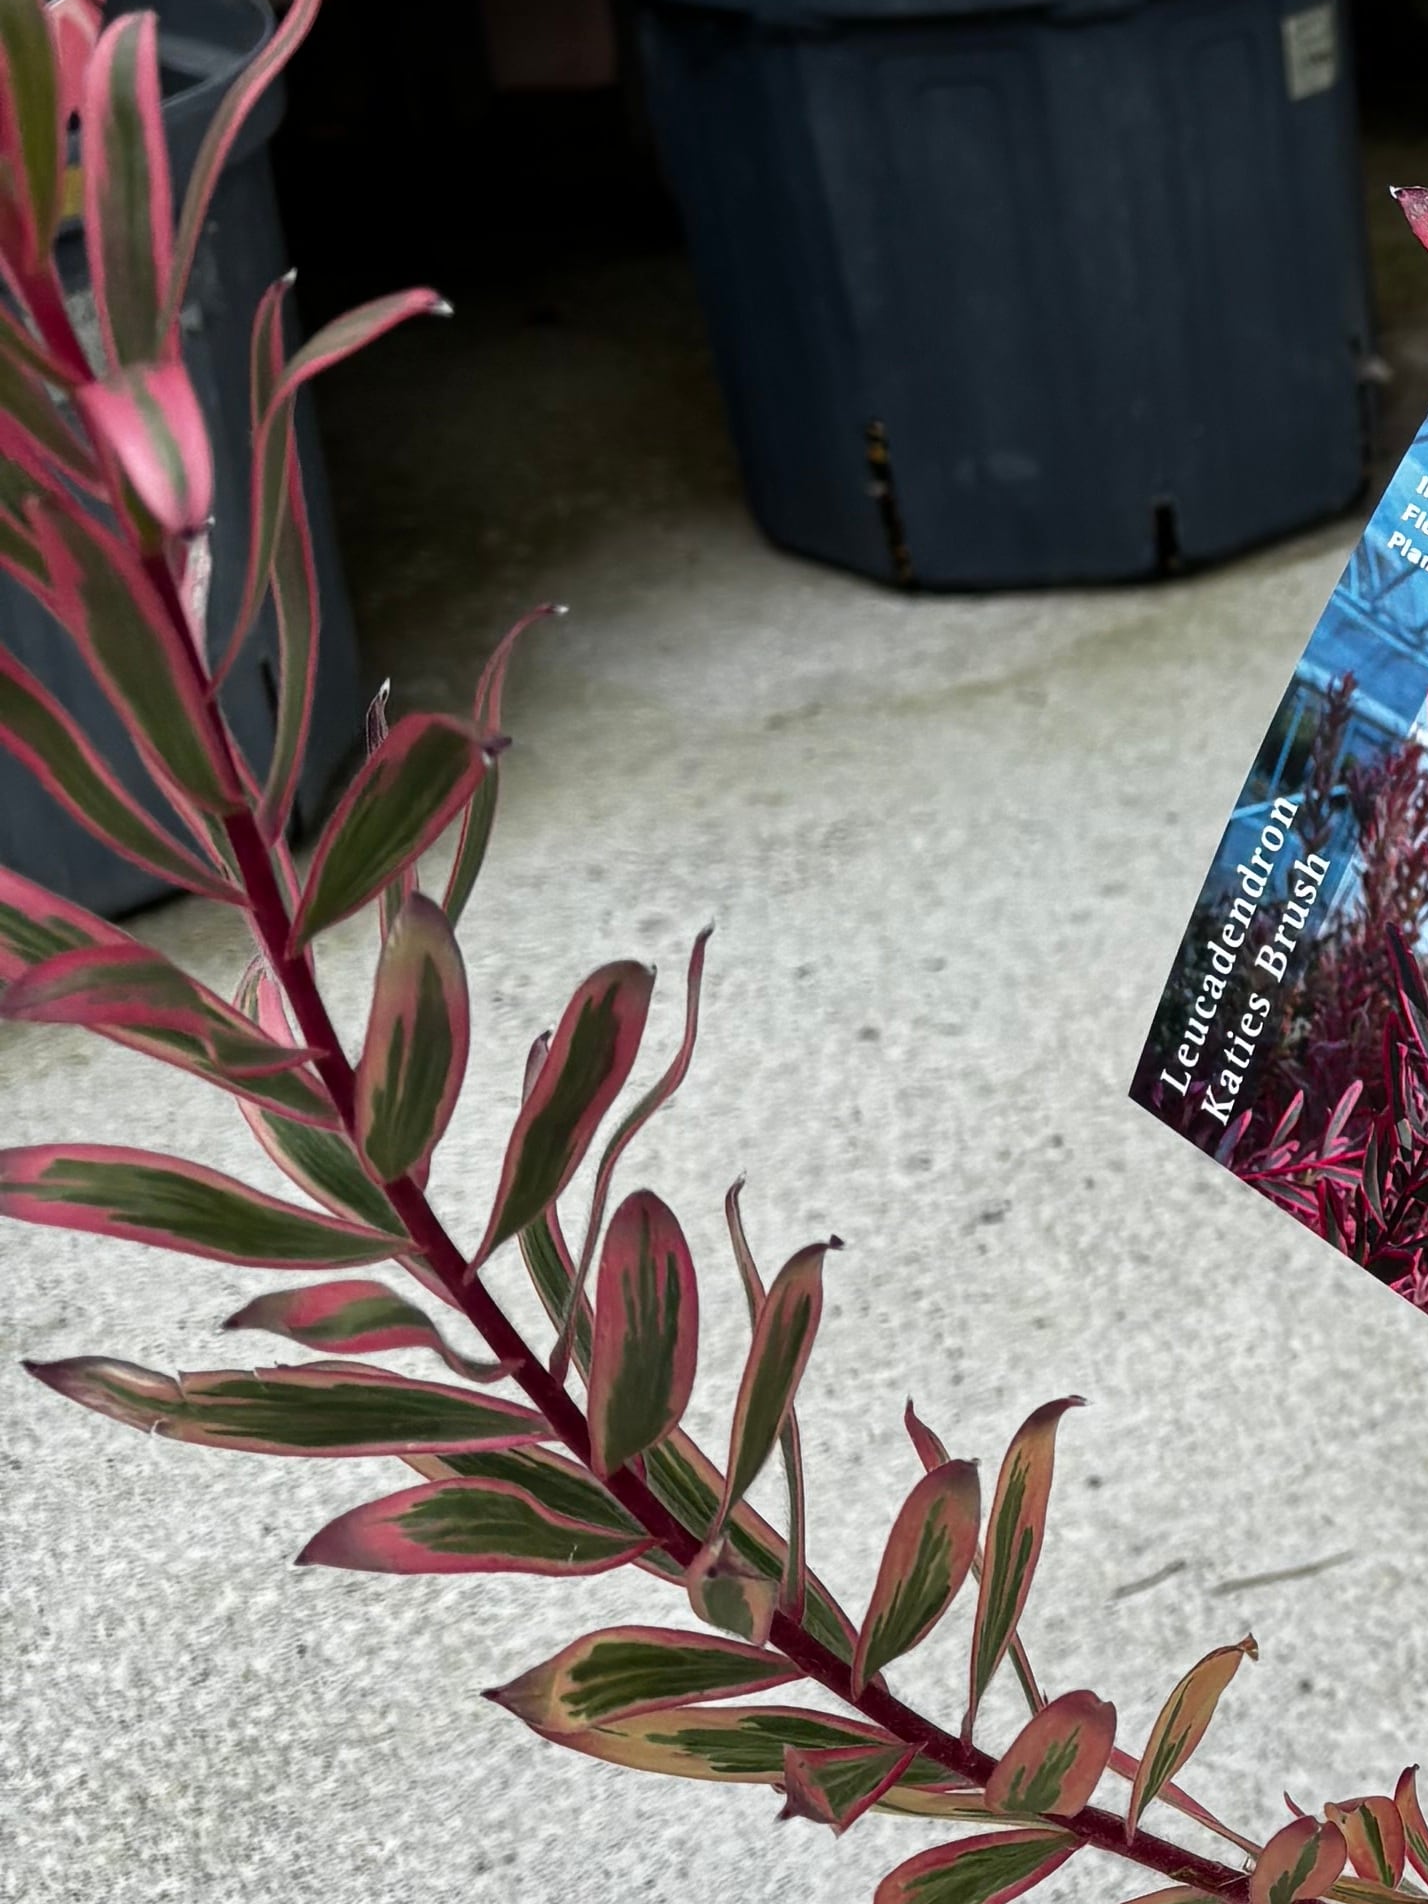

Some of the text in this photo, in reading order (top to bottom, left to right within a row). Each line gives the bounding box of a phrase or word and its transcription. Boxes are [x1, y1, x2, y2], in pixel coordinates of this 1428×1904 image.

[1160, 796, 1299, 1096] Leucadendron
[1201, 852, 1331, 1126] Katies Brush
